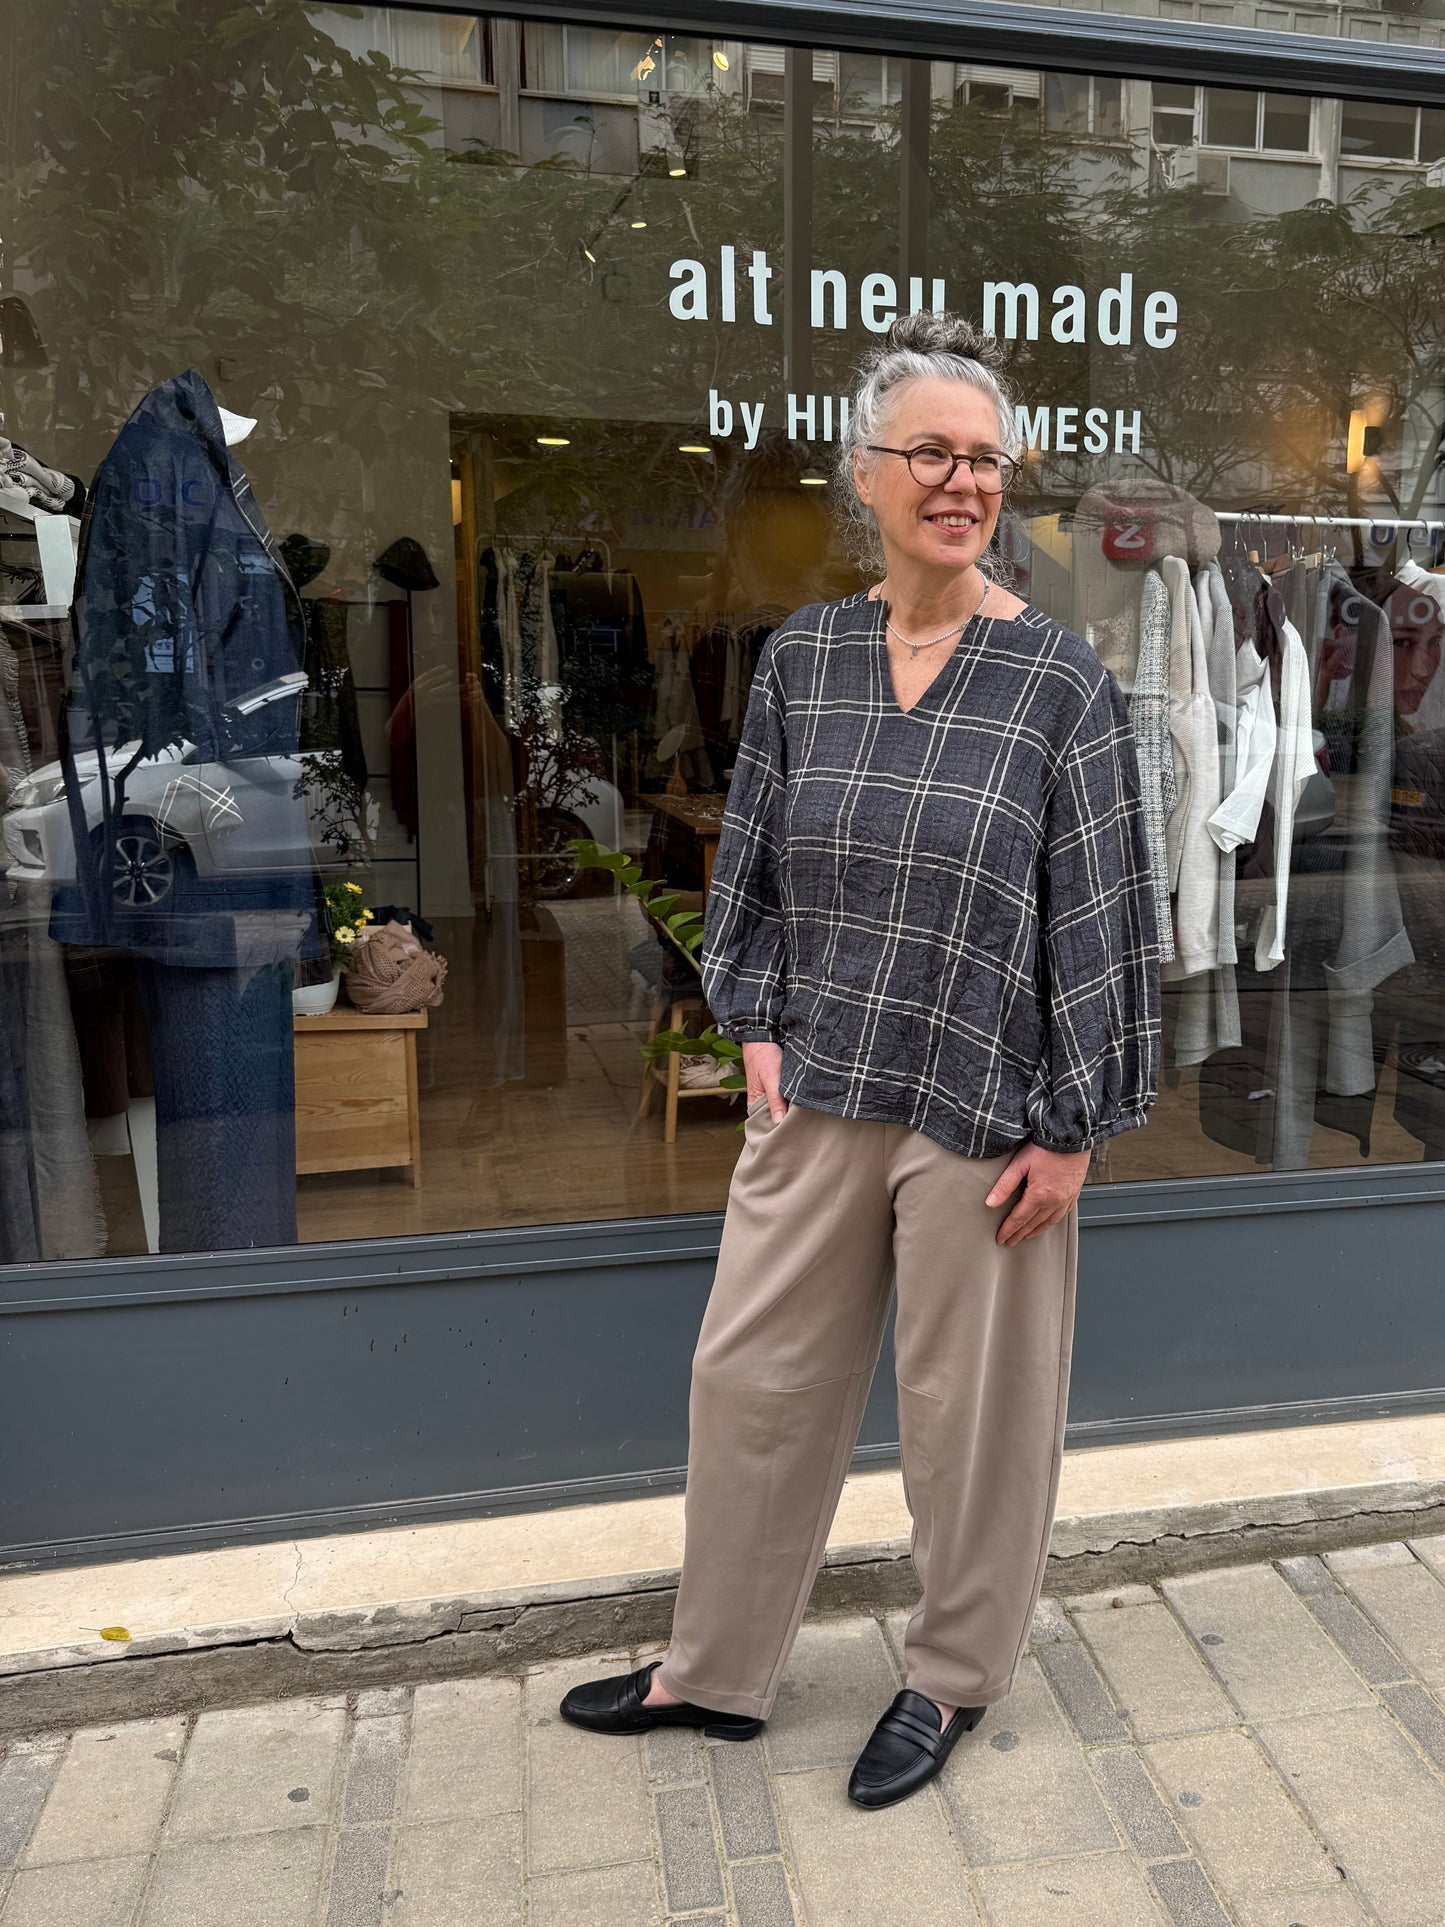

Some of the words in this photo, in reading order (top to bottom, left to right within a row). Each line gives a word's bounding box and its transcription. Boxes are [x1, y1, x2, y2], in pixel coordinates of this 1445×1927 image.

[669, 245, 773, 325] alt
[810, 269, 946, 333] neu
[983, 272, 1179, 348] made
[709, 389, 764, 450] by
[787, 393, 850, 442] HIL
[1014, 405, 1142, 454] MESH
